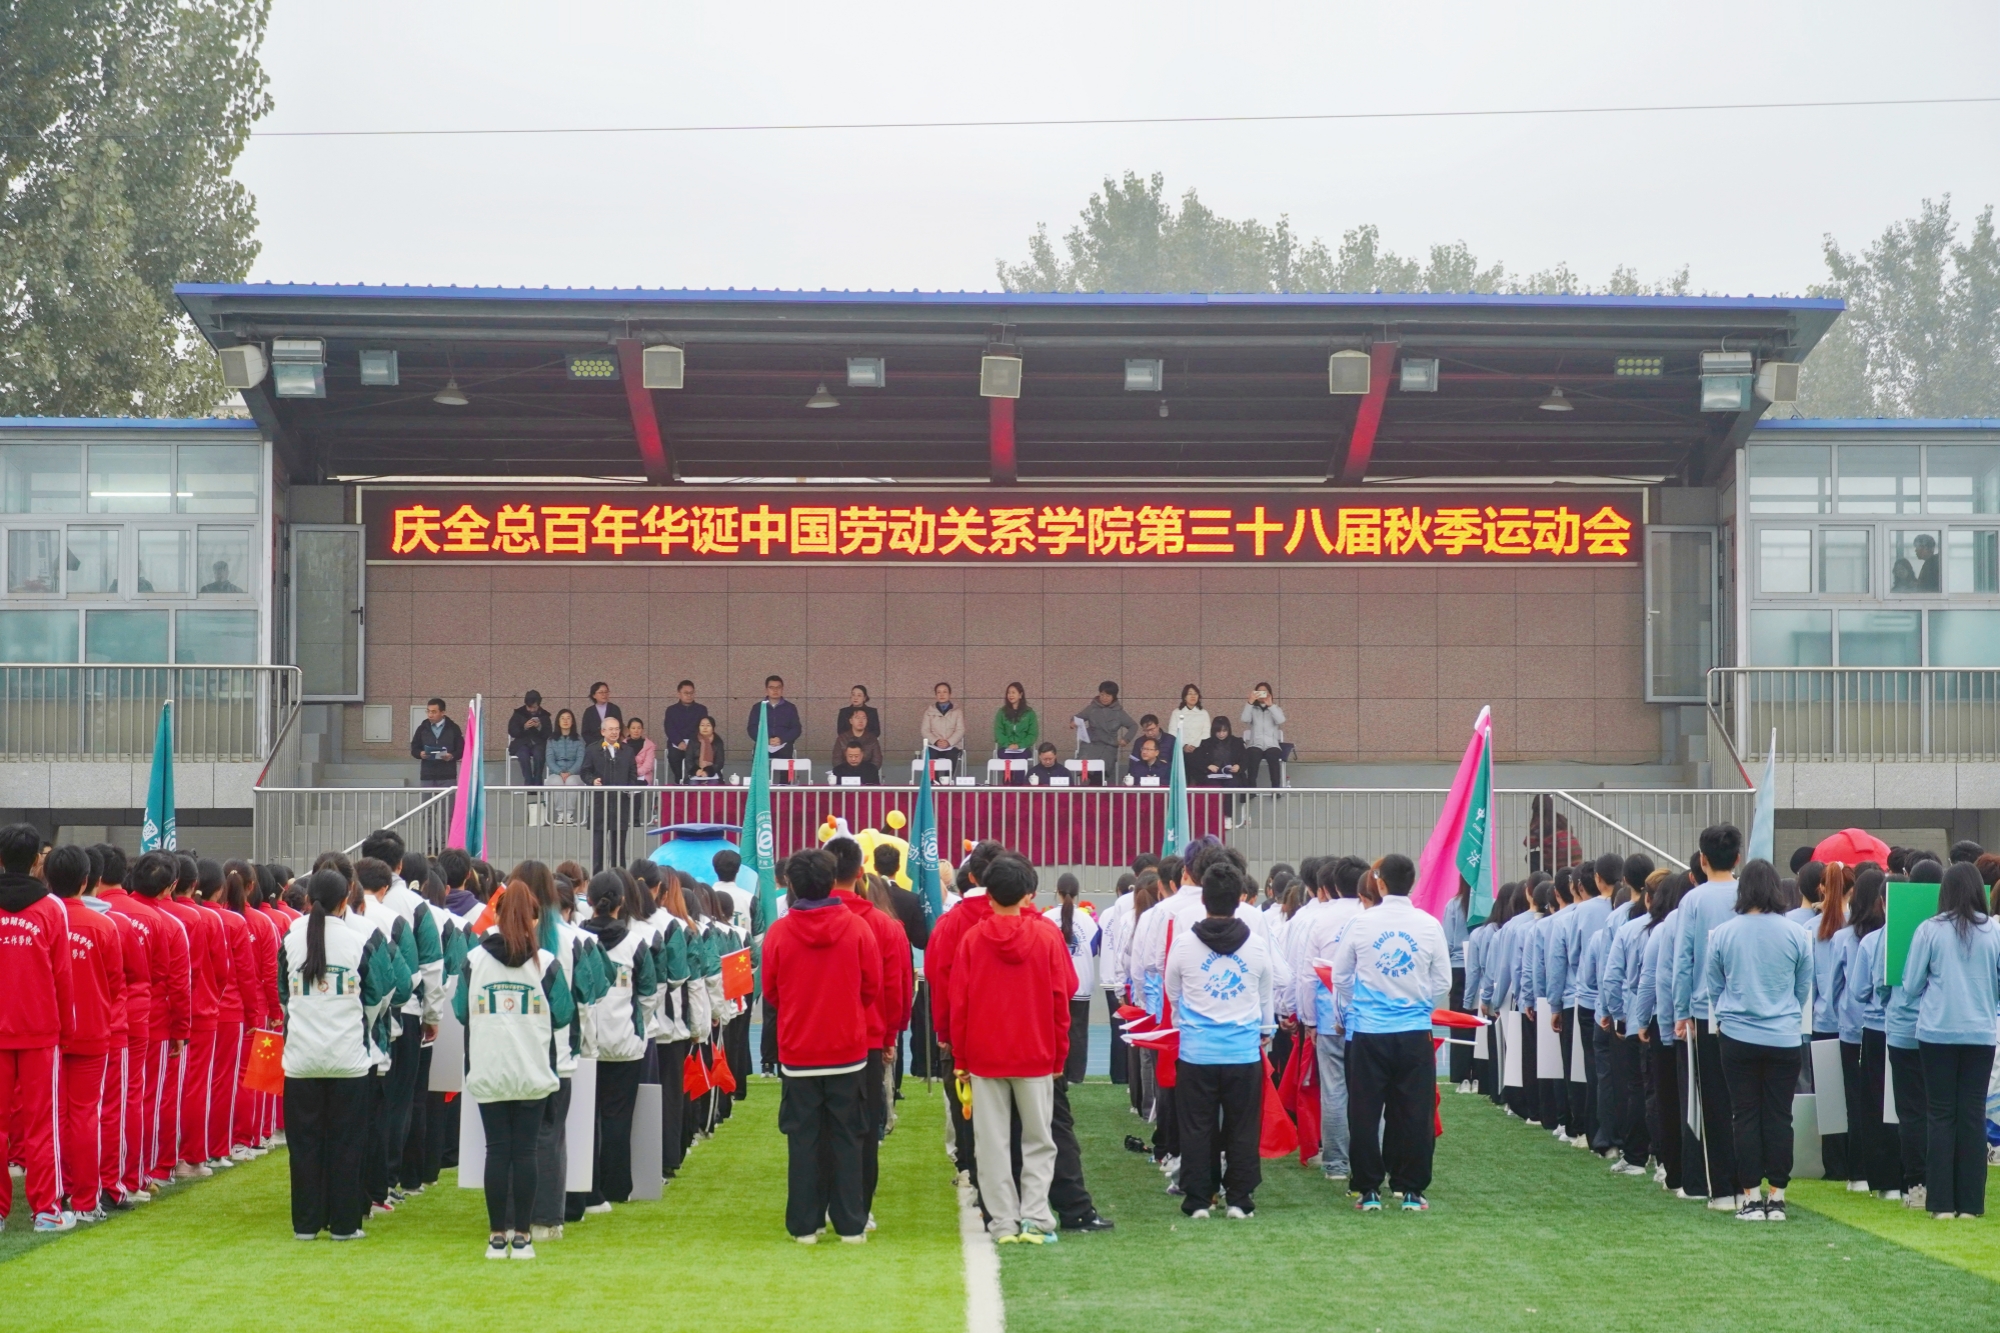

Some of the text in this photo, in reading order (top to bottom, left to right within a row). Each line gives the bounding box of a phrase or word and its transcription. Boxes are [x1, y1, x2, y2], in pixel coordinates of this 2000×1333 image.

[391, 504, 1632, 557] 庆全总百年华诞中国劳动关系学院第三十八届秋季运动会
[1372, 931, 1419, 953] Hello world
